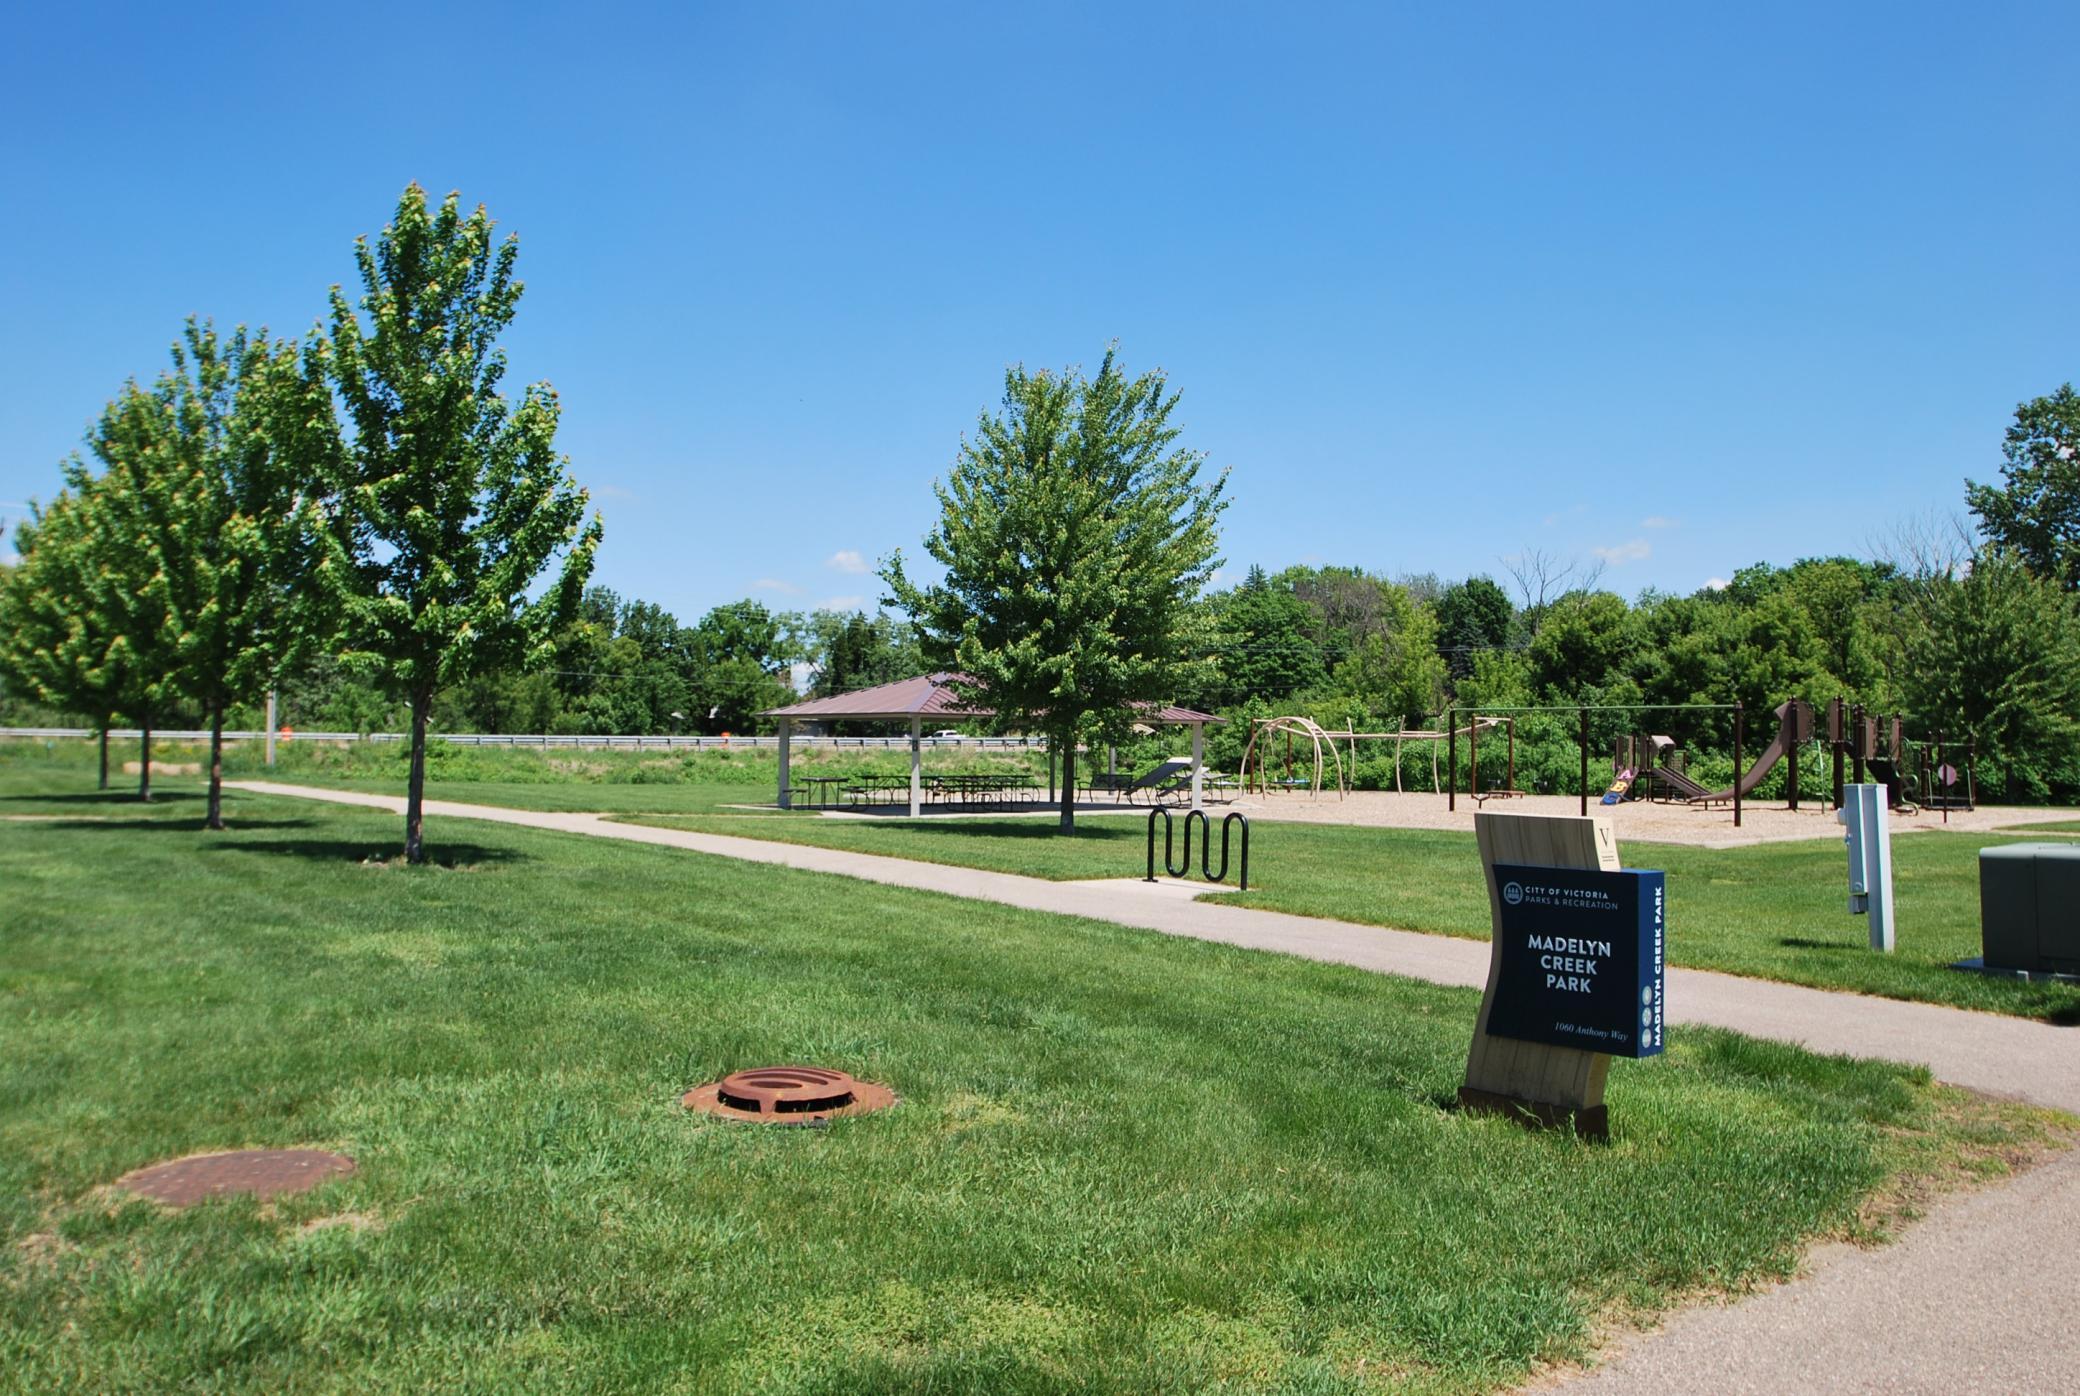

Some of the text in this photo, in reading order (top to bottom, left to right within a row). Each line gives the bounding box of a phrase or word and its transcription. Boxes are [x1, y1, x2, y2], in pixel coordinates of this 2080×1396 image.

[1599, 828, 1609, 847] V
[1525, 886, 1545, 895] CITY
[1563, 889, 1608, 899] VICTORIA
[1525, 895, 1618, 910] PARKS & RECREATION
[1528, 934, 1611, 958] MADELYN
[1654, 928, 1662, 974] CREEK
[1540, 954, 1597, 975] CREEK
[1546, 973, 1591, 993] PARK
[1654, 979, 1662, 1046] MADELYN
[1555, 1021, 1629, 1042] 1060 Anthony Way
